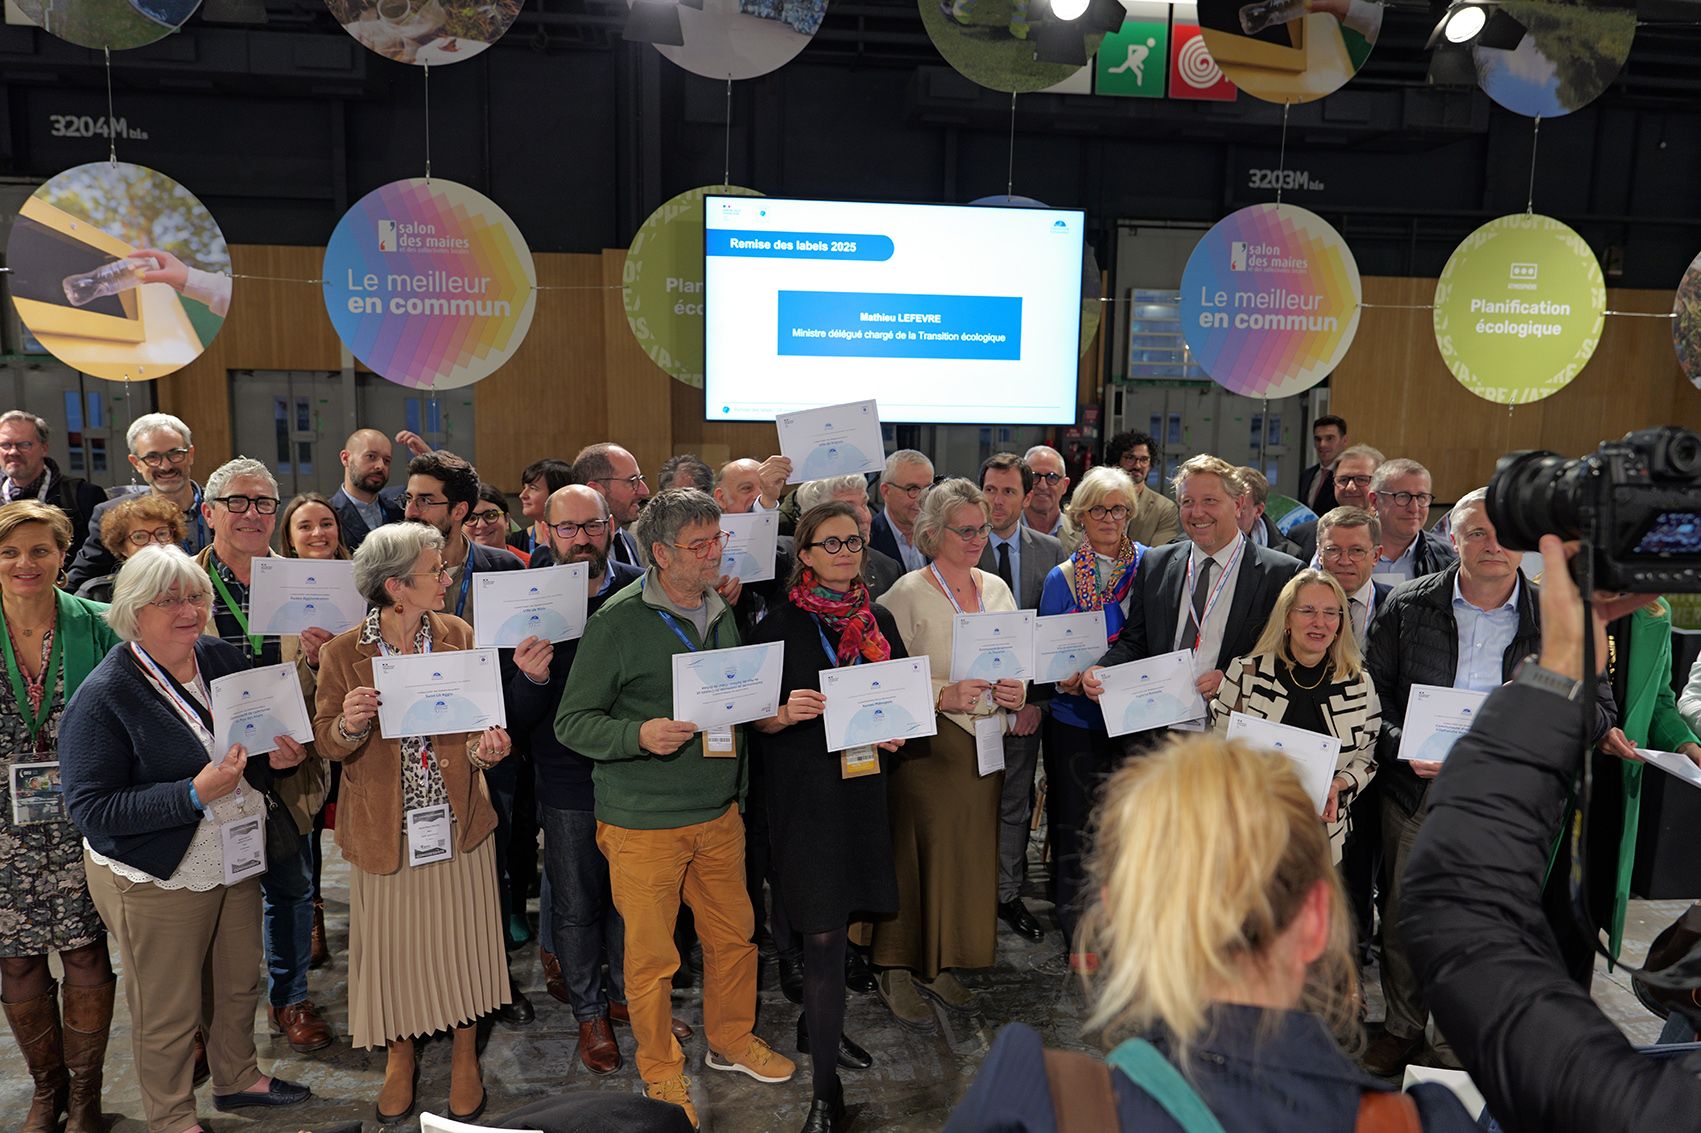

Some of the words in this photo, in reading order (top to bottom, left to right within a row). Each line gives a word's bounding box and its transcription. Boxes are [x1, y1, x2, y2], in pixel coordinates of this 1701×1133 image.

[399, 221, 436, 234] salon
[400, 234, 422, 247] des
[426, 235, 470, 248] maires
[729, 238, 771, 250] Remise
[773, 239, 794, 250] des
[796, 240, 829, 251] labels
[830, 241, 857, 252] 2025
[1248, 243, 1280, 255] salon
[1248, 254, 1268, 267] des
[1271, 256, 1308, 269] maires
[348, 268, 379, 291] Le
[387, 271, 491, 294] meilleur
[1201, 286, 1228, 307] Le
[1234, 288, 1324, 310] meilleur
[347, 296, 382, 314] en
[389, 297, 511, 317] commun
[1470, 298, 1571, 316] Planification
[860, 312, 897, 322] Mathieu
[897, 313, 942, 324] LEFEVRE
[1199, 311, 1229, 328] en
[1234, 312, 1338, 332] commun
[792, 328, 826, 338] Ministre
[828, 328, 863, 340] délégué
[864, 329, 893, 341] chargé
[895, 331, 907, 340] de
[908, 331, 916, 340] la
[918, 331, 959, 341] Transition
[961, 332, 1006, 343] écologique
[1475, 319, 1562, 338] écologique
